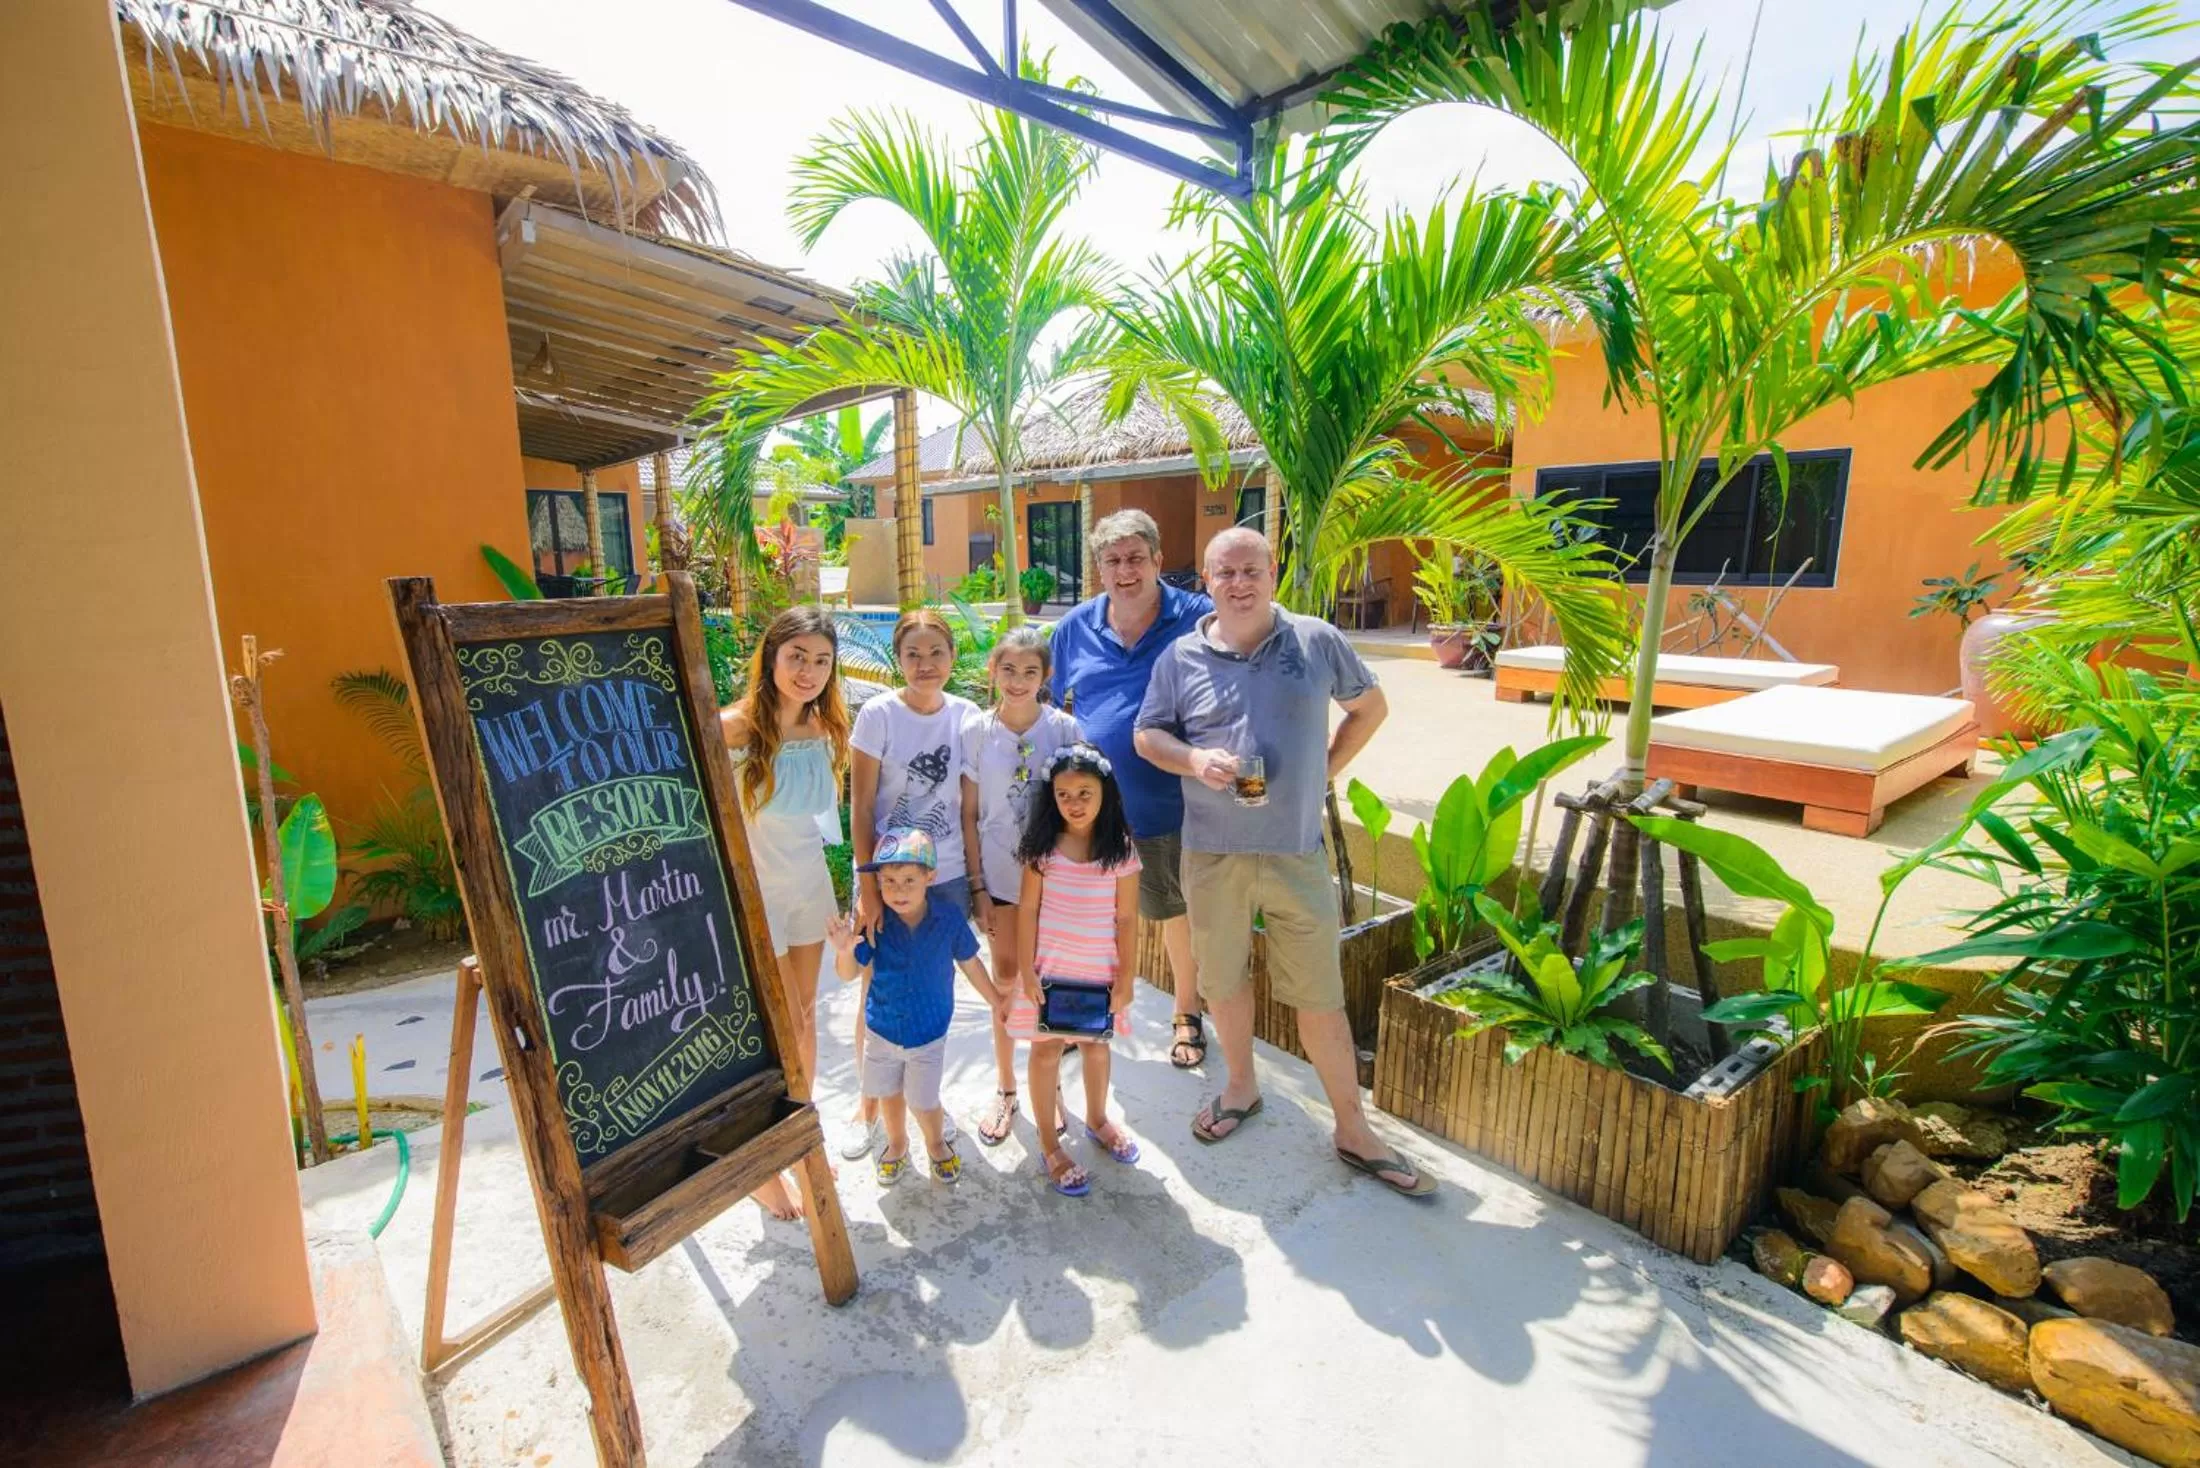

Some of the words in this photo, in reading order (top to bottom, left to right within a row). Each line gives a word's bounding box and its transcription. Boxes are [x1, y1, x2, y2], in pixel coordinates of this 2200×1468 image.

[477, 680, 672, 783] WELCOME
[548, 739, 609, 791] TO
[611, 728, 686, 776] OUR
[538, 779, 681, 861] RESORT
[598, 860, 704, 931] Martin
[548, 912, 727, 1051] Family!
[607, 926, 658, 975] &
